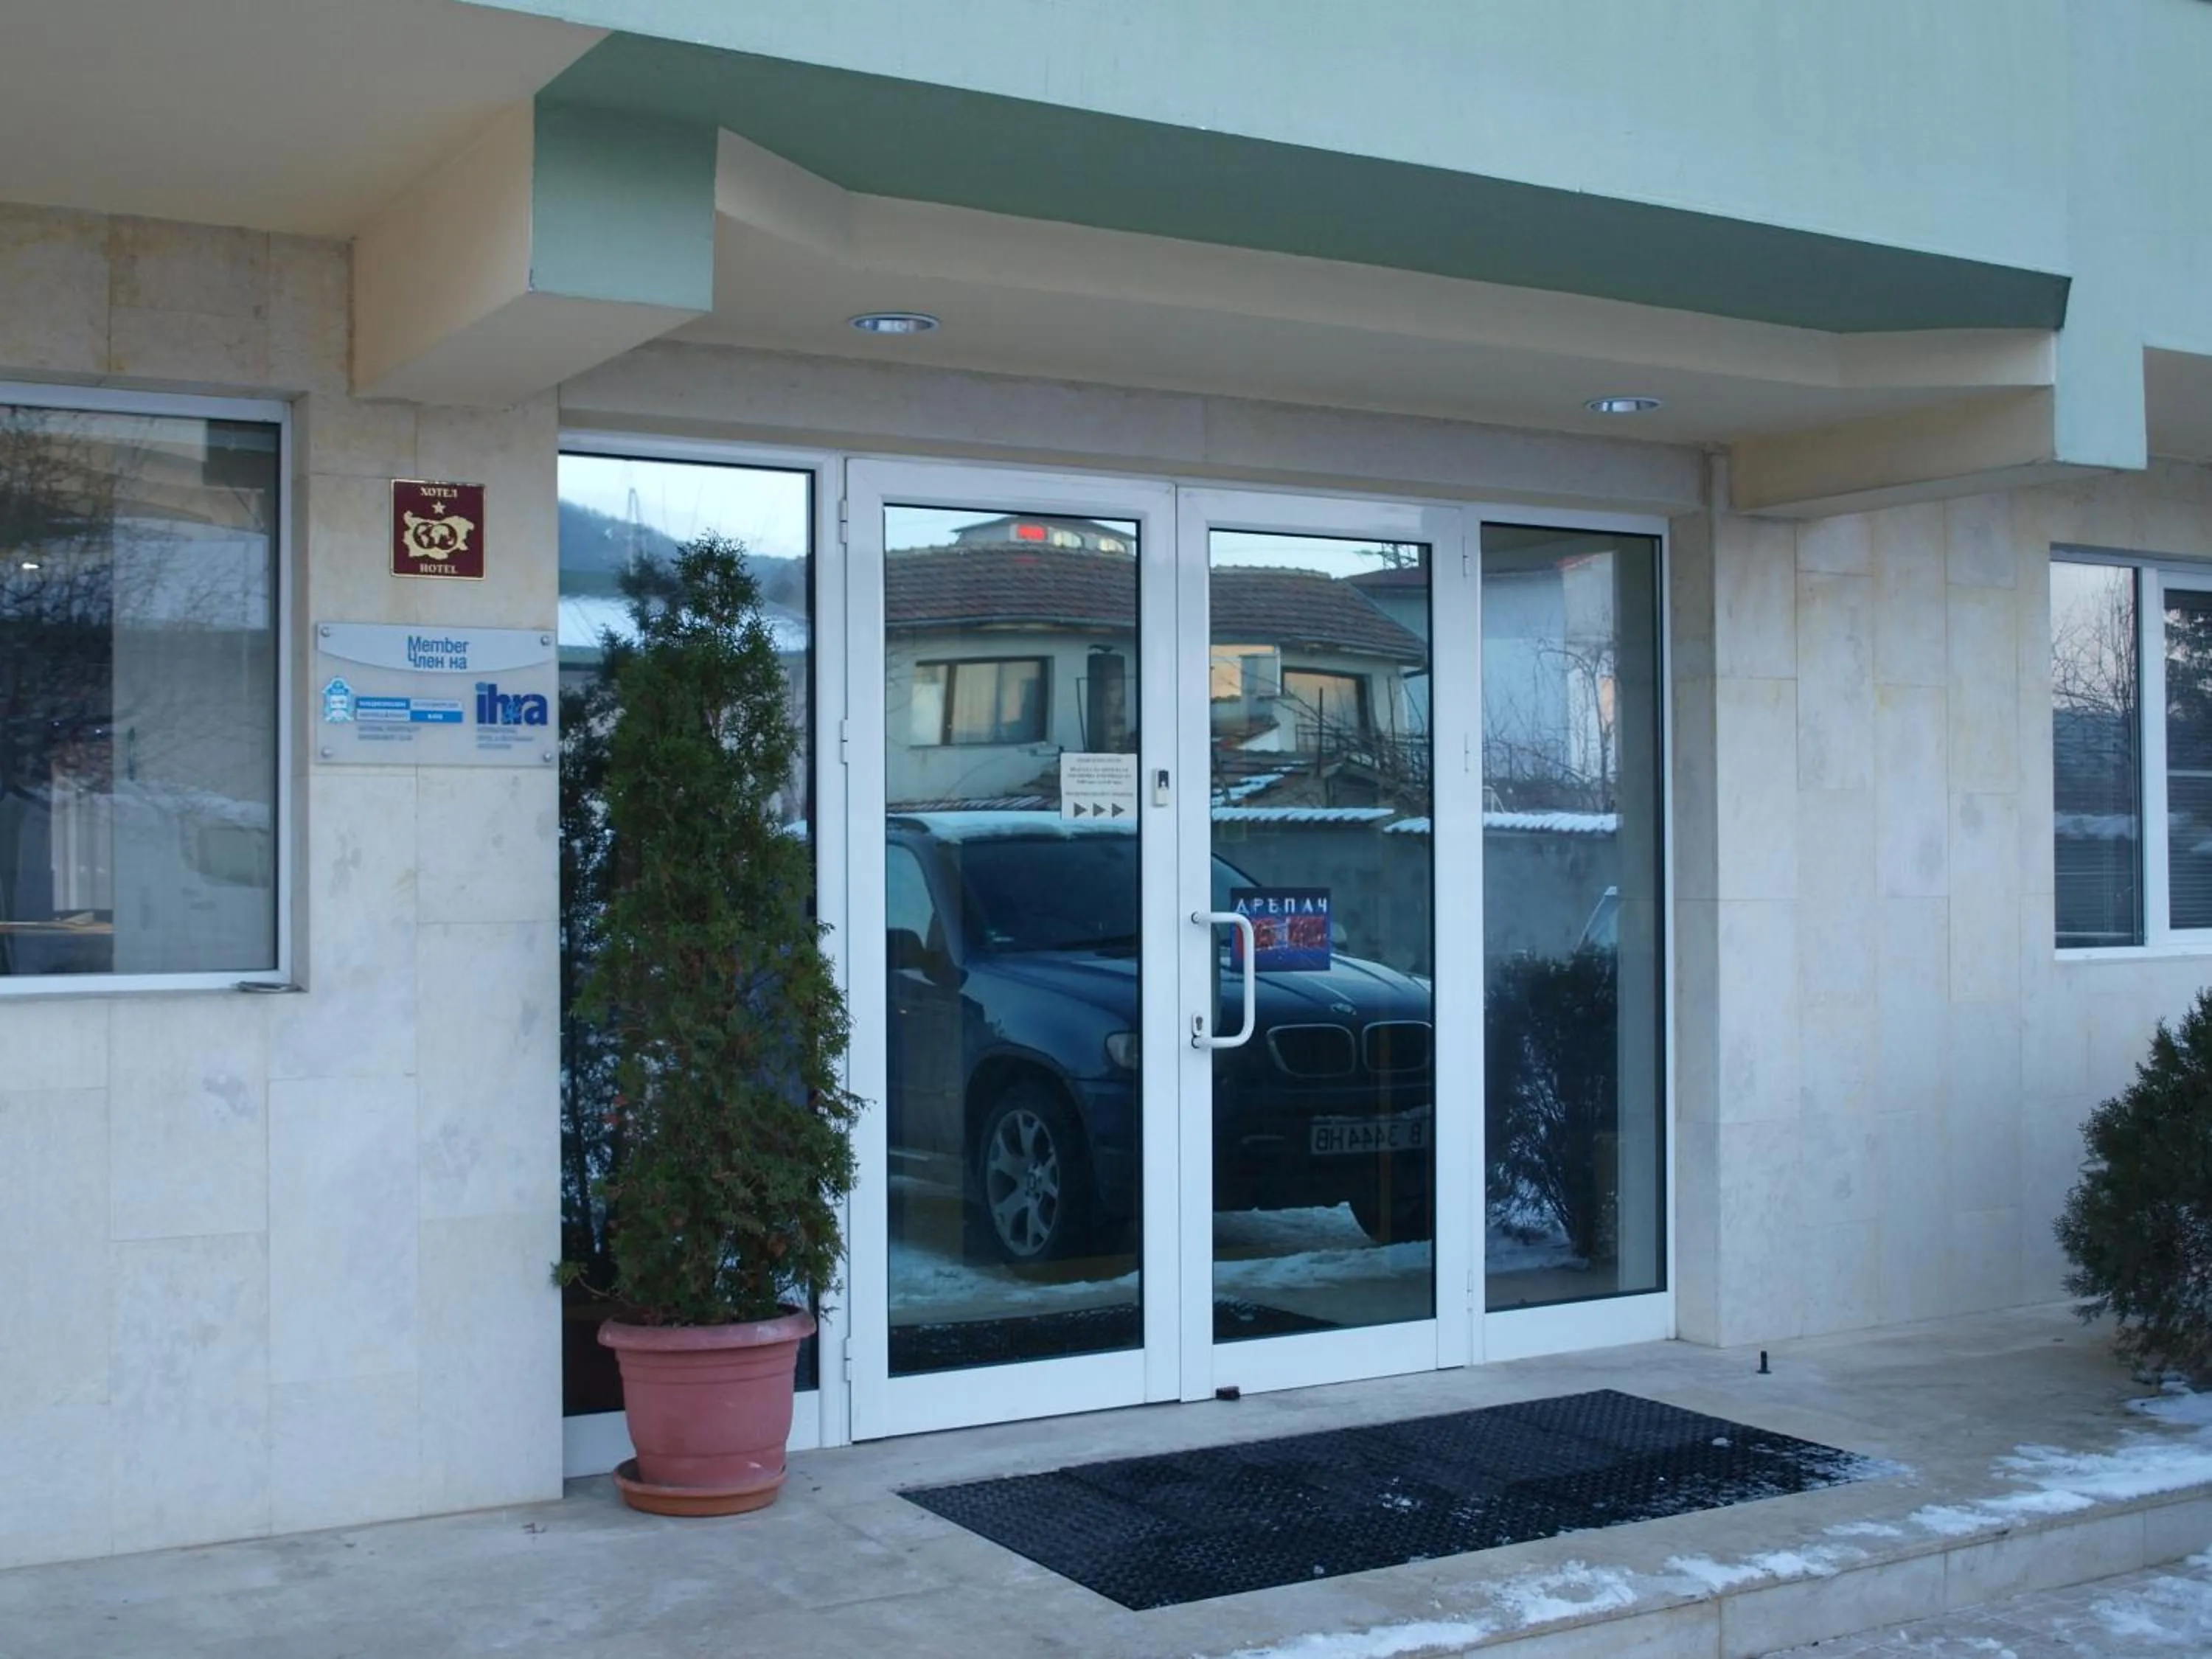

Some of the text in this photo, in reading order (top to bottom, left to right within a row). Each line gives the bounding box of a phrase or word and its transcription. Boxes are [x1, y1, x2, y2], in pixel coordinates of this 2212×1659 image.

[420, 487, 458, 498] ХОТЕЛ
[419, 563, 459, 574] HOTEL
[408, 636, 470, 653] Member
[408, 650, 467, 669] Член на
